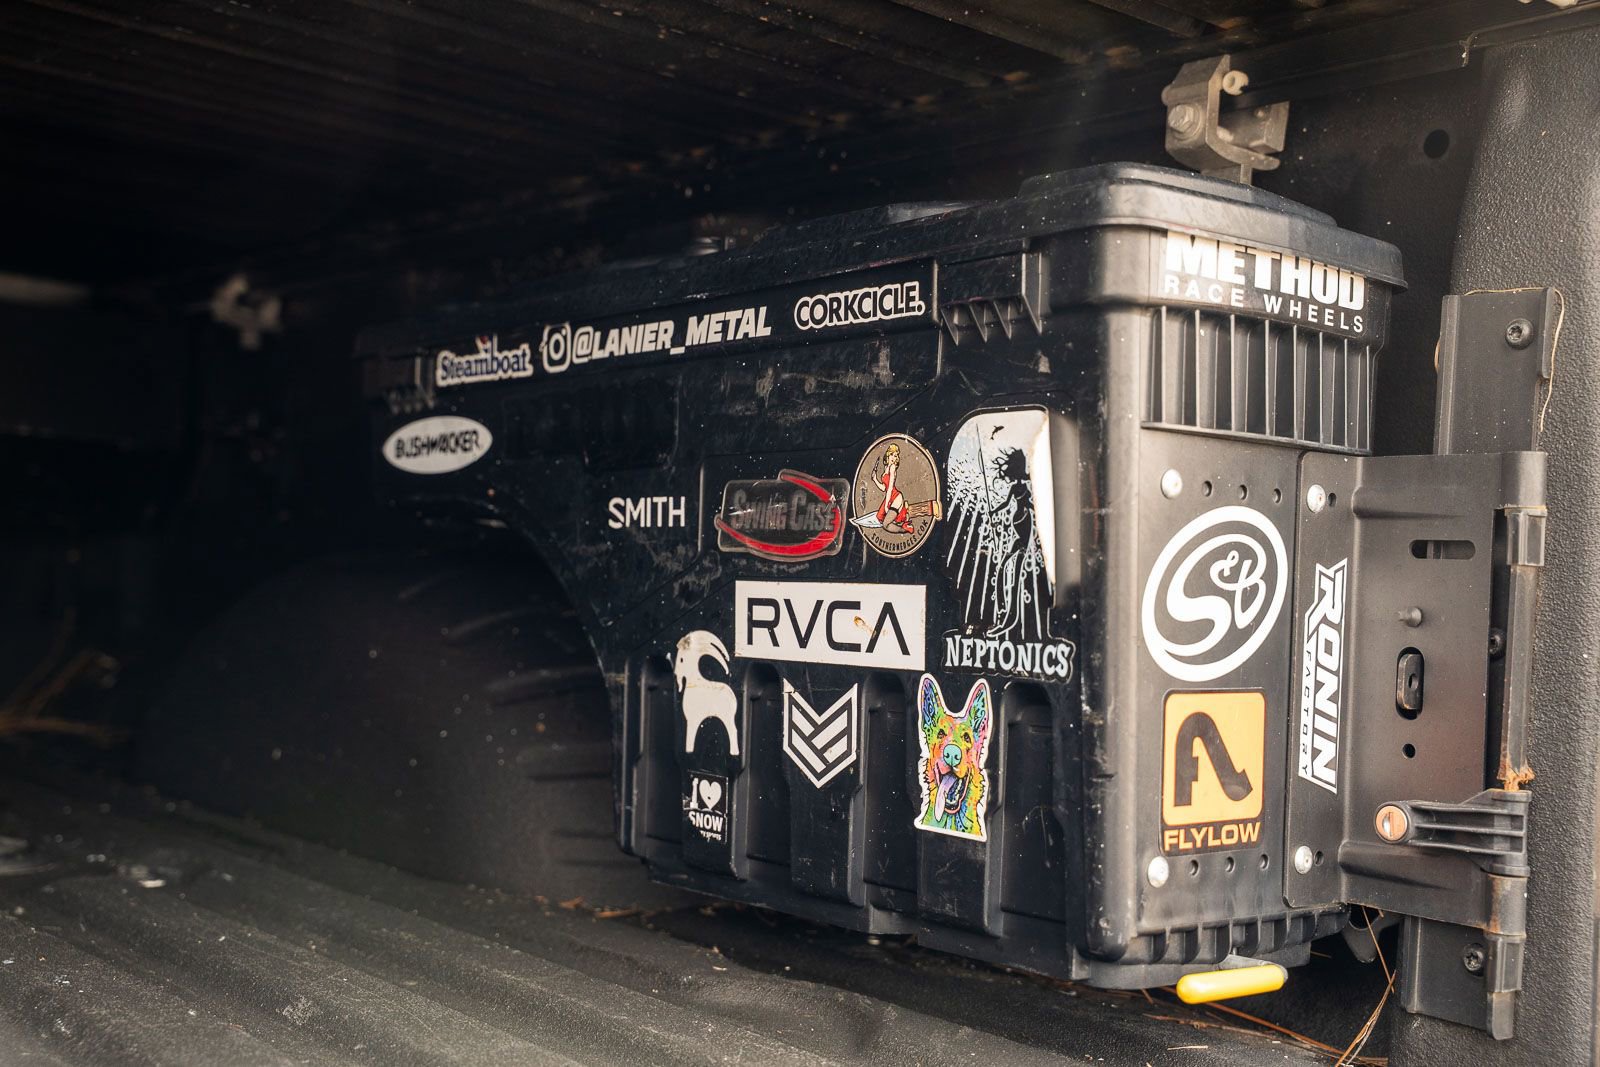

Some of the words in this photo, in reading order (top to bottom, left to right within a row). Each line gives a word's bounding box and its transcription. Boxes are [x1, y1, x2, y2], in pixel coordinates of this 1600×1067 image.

[1166, 231, 1365, 311] METHOD
[1164, 274, 1244, 308] RACE
[1263, 294, 1364, 333] WHEELS
[572, 306, 772, 364] @LANIER_METAL
[438, 343, 531, 384] Steamboat
[608, 496, 686, 529] SMITH
[746, 597, 911, 656] RVCA
[944, 634, 1072, 678] NEPTONICS
[1307, 567, 1344, 787] RONIN
[1301, 650, 1313, 776] FACTORY
[689, 777, 699, 809] I
[688, 810, 723, 832] SNOW
[1163, 822, 1261, 851] FLYLOW
